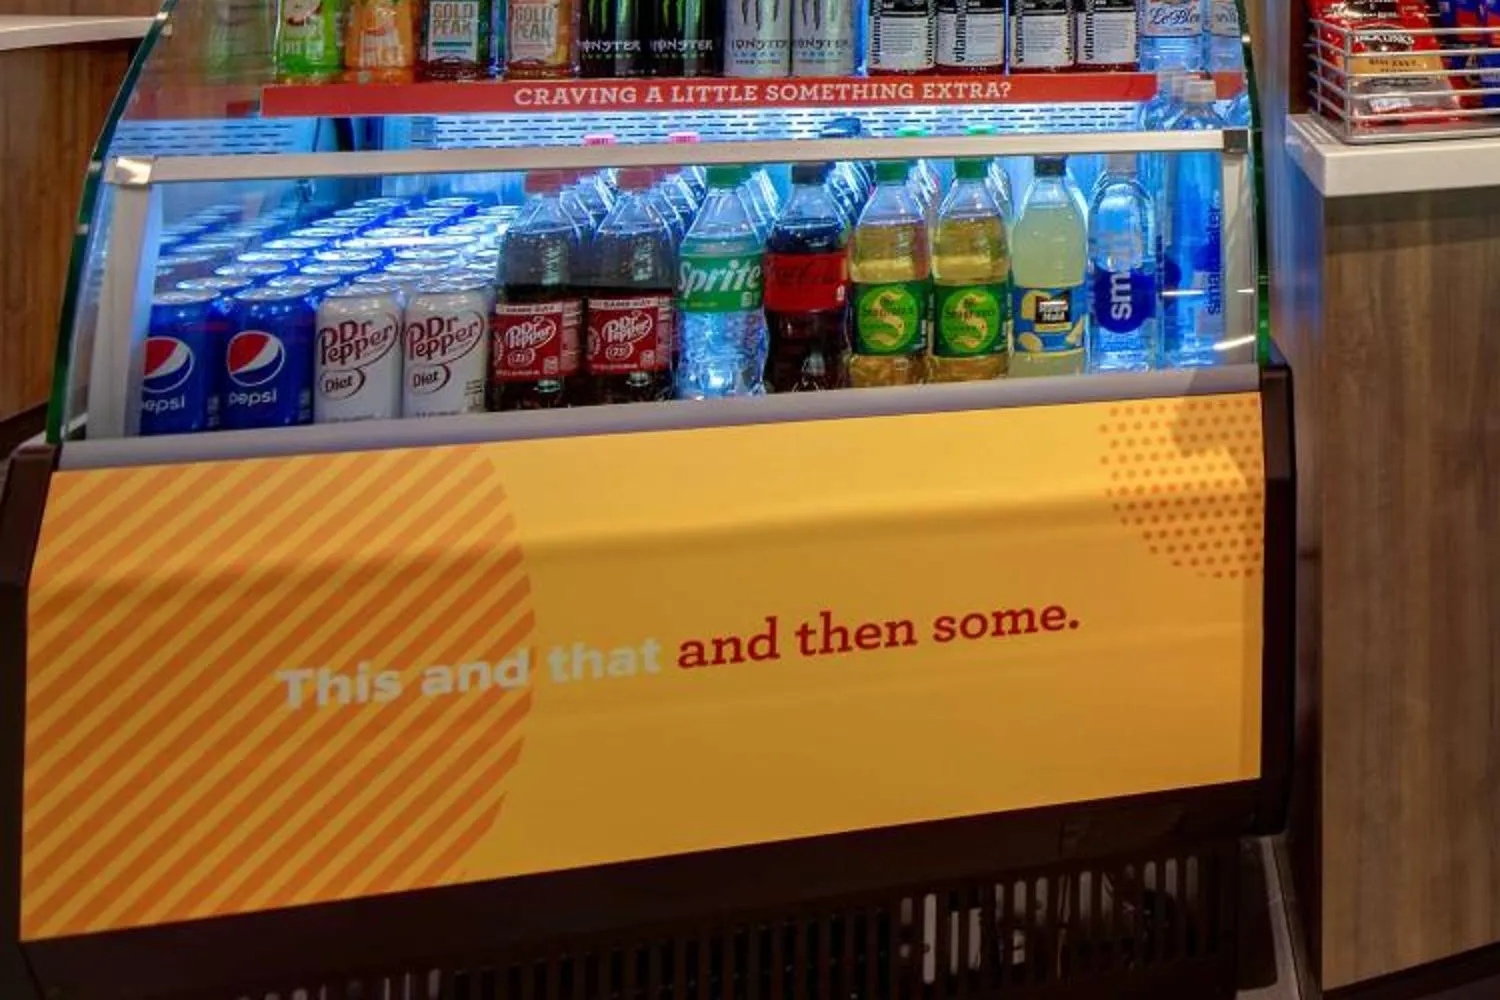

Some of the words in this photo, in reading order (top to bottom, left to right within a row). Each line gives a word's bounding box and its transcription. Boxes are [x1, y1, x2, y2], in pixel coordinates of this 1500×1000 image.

[433, 3, 473, 19] GOLD
[432, 19, 473, 35] PEAK
[514, 86, 637, 105] CRAVING
[645, 86, 664, 103] A
[671, 85, 758, 103] LITTLE
[765, 82, 914, 101] SOMETHING
[922, 81, 1012, 99] EXTRA?
[677, 258, 762, 300] Sprite
[339, 319, 373, 344] Dr
[426, 315, 459, 339] Dr
[319, 323, 393, 366] Pepper
[405, 319, 479, 361] Pepper
[325, 374, 353, 394] Diet
[413, 369, 439, 389] Diet
[143, 395, 185, 416] epsi
[228, 387, 278, 407] pepsi
[277, 661, 402, 709] This
[421, 649, 529, 698] and
[548, 638, 661, 684] that
[677, 615, 781, 669] and
[794, 610, 918, 658] then
[933, 605, 1081, 643] some.
